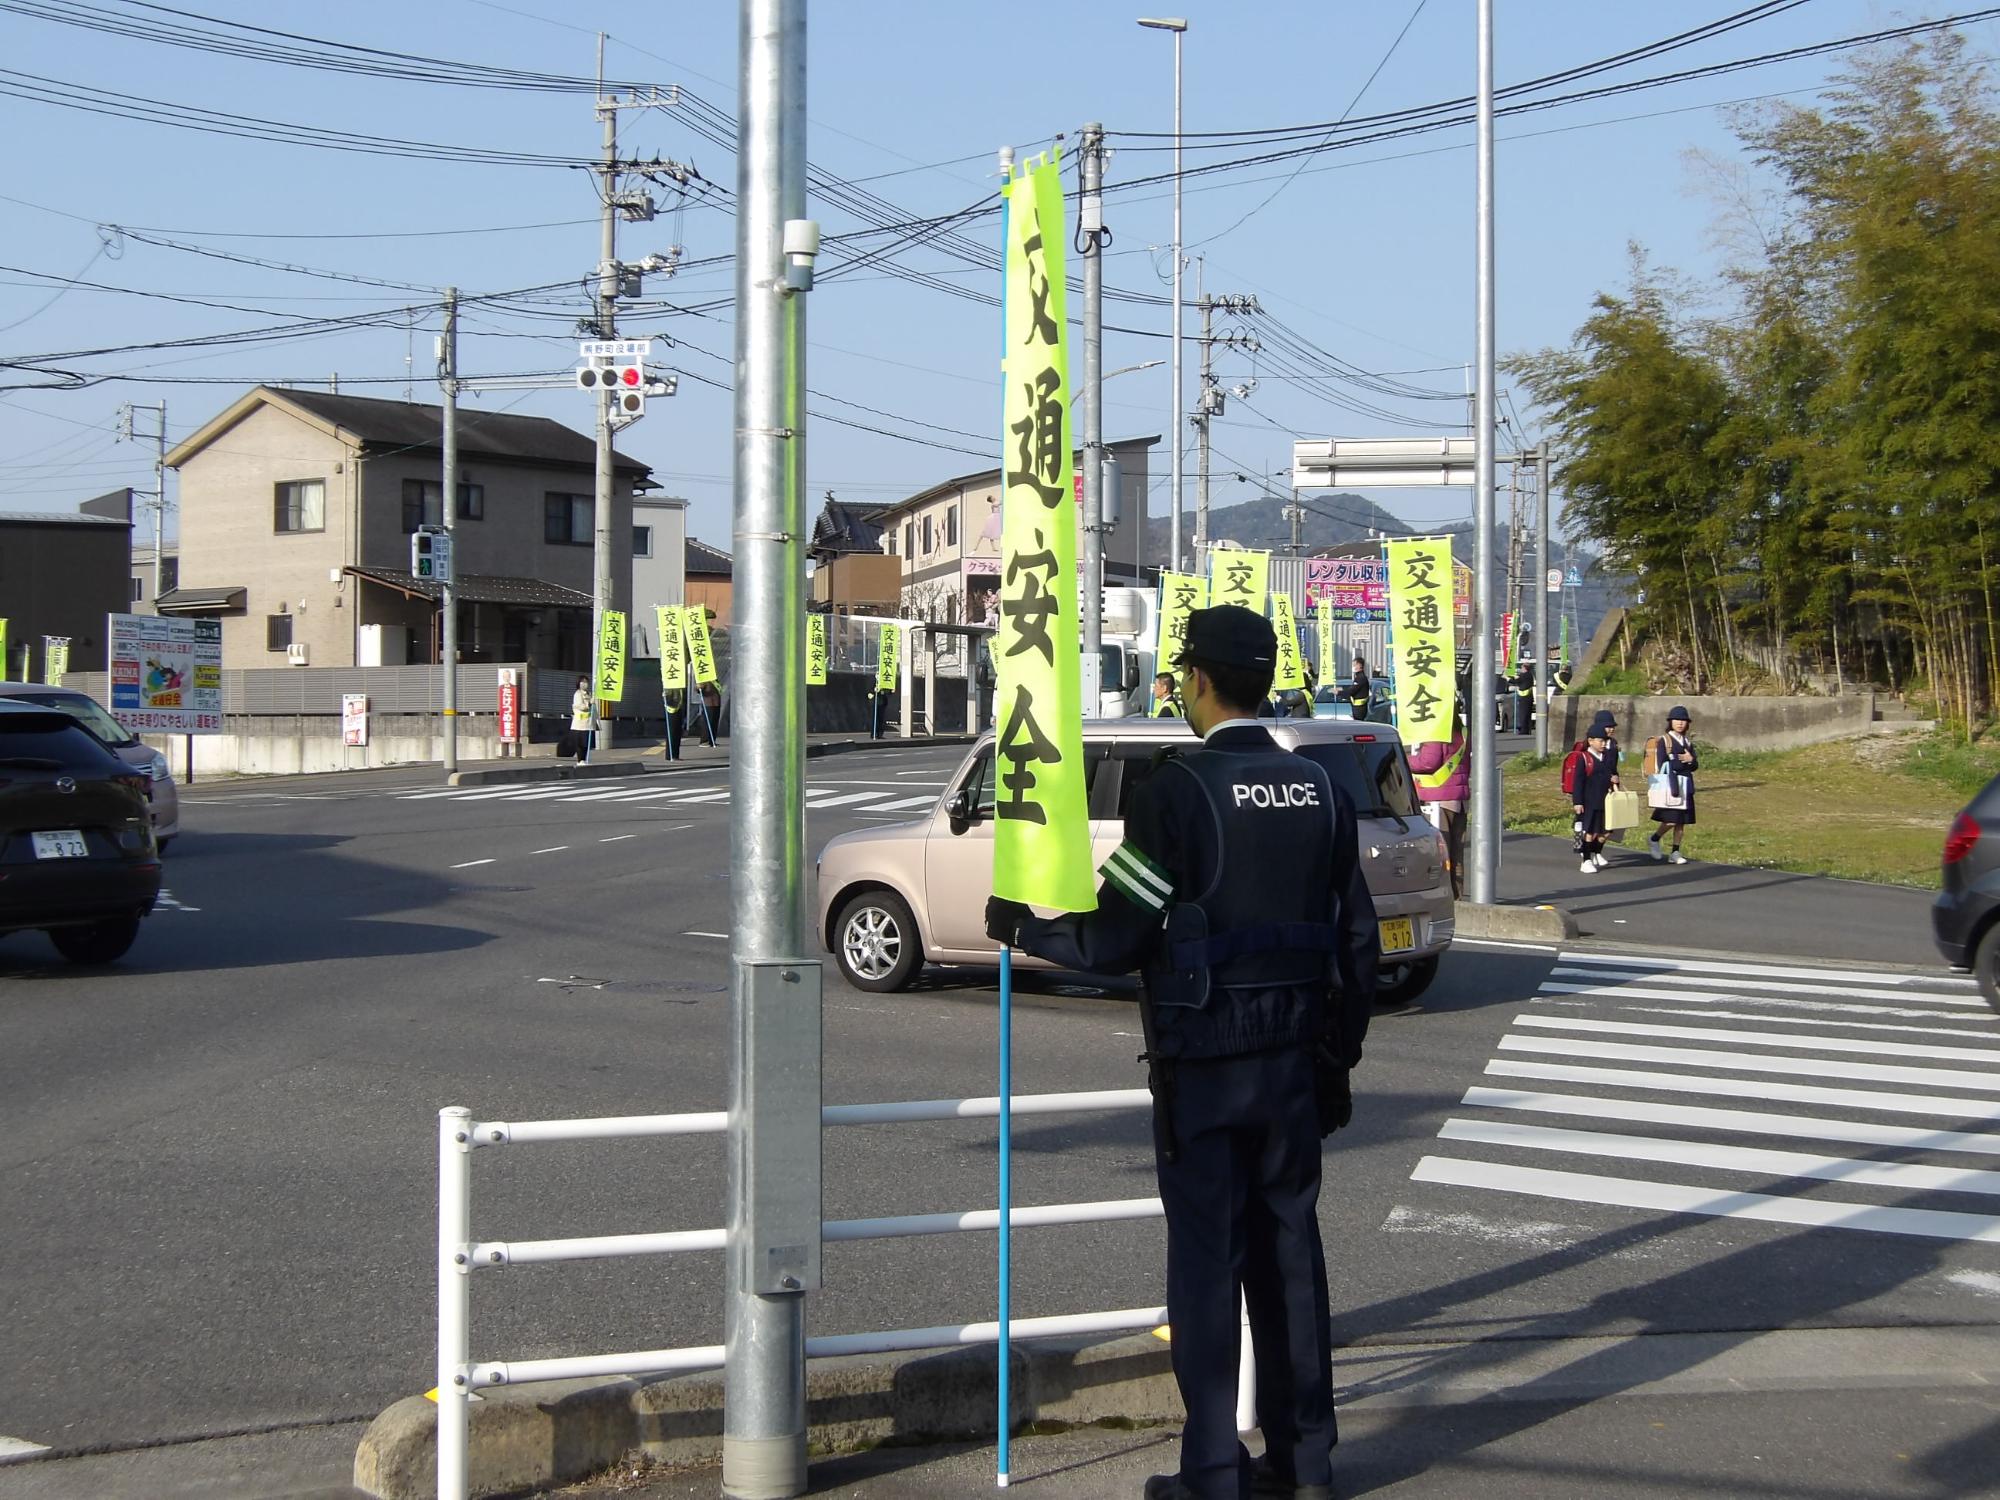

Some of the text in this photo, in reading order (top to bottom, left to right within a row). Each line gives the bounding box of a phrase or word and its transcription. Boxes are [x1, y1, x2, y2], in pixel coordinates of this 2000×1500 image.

[968, 562, 1001, 573] クラシ
[601, 616, 621, 691] 交通安全
[664, 611, 681, 680] 交通安全
[688, 611, 709, 675] 交通安全
[811, 619, 824, 677] 交通安全
[882, 628, 894, 682] 交通安全
[1277, 598, 1297, 679] 交通安全
[1403, 551, 1442, 723] 交通安全
[1232, 783, 1320, 808] POLICE
